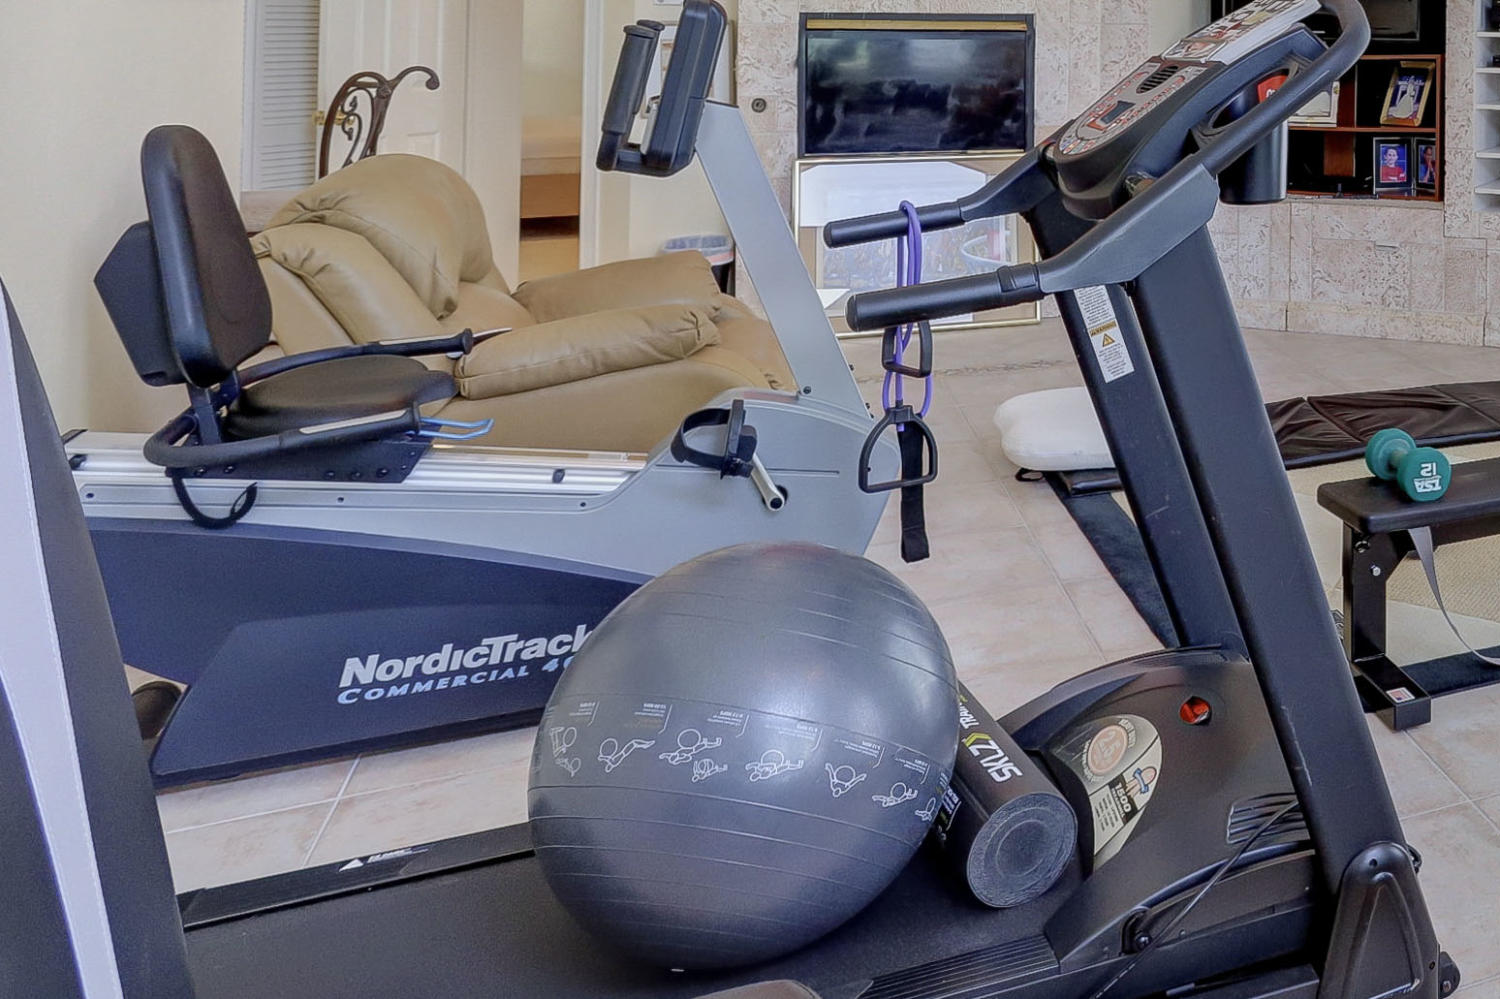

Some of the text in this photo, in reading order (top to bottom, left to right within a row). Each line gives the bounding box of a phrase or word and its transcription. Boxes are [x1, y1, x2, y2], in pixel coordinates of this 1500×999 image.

[1420, 462, 1437, 477] 12
[338, 624, 594, 688] NordicTrack
[337, 664, 530, 705] COMMERCIAL
[968, 739, 1024, 783] SKLZ
[1114, 781, 1132, 813] 1500
